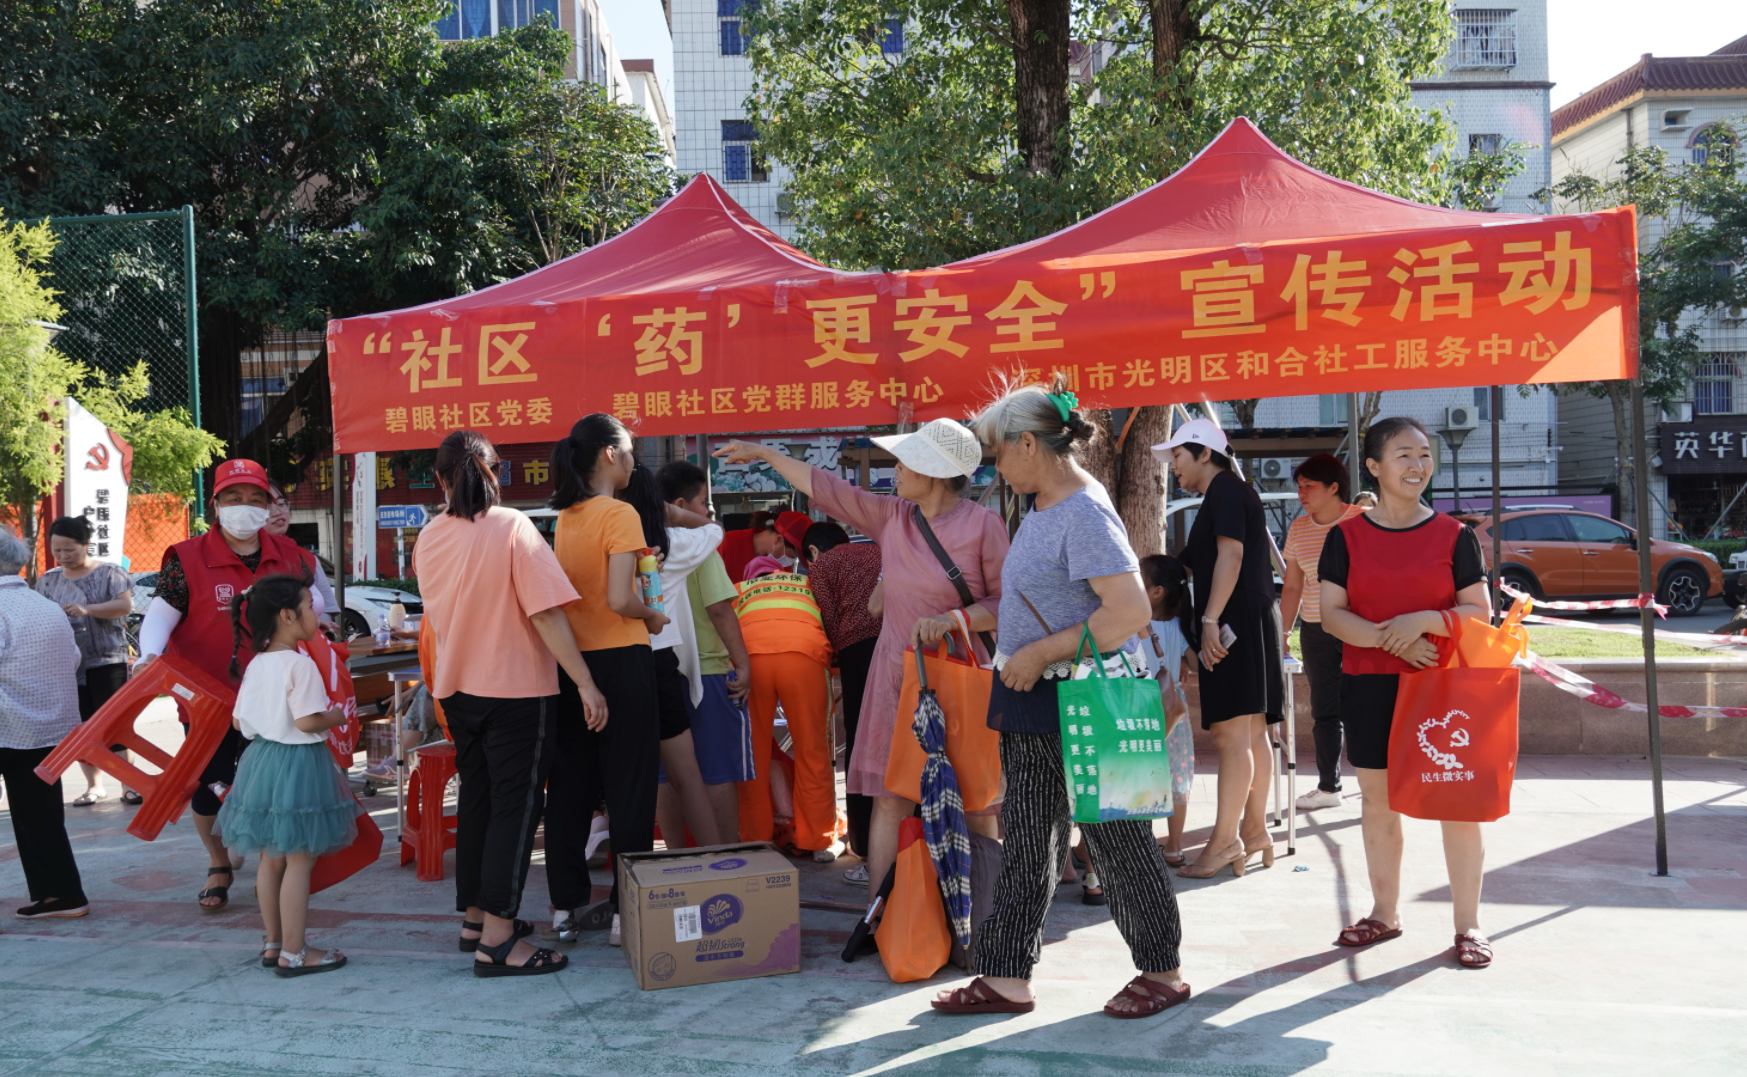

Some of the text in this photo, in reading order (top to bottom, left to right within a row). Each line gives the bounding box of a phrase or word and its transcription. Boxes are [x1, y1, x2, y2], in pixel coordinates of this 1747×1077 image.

[1180, 231, 1593, 340] 宣传活动
[1012, 331, 1558, 393] 深圳市光明区和合社工服务中心
[385, 396, 553, 434] 碧眼社区党委
[612, 375, 944, 422] 碧眼社区党群服务中心
[1674, 431, 1747, 459] 英华
[1115, 718, 1161, 732] 垃圾不落地
[1067, 704, 1085, 795] 光明更美丽
[1079, 705, 1098, 796] 垃圾不落地
[1118, 739, 1162, 753] 光明更美丽
[1421, 770, 1475, 783] 民生微实事
[765, 875, 791, 884] V2239
[707, 911, 733, 925] Vinda
